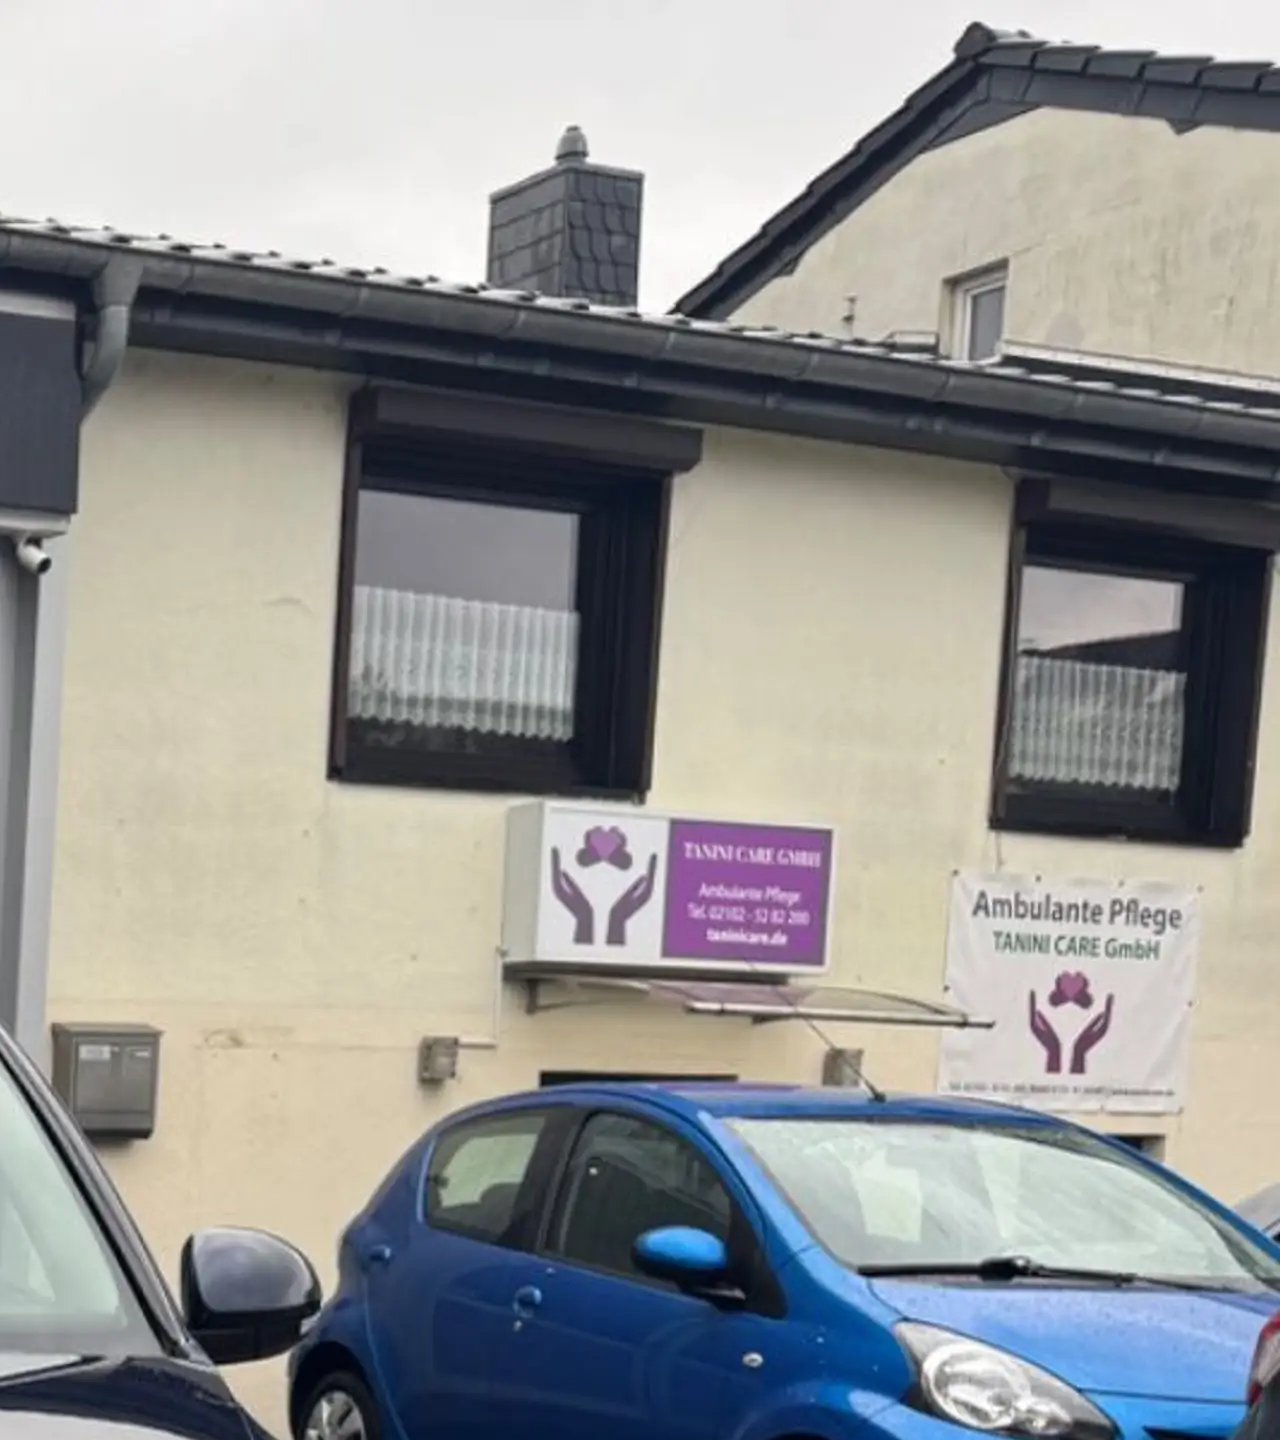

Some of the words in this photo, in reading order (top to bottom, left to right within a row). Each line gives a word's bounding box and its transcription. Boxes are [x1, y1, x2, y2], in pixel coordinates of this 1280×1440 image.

[684, 842, 733, 861] TANINI
[737, 846, 774, 865] CARE
[699, 883, 762, 900] Ambulante
[971, 889, 1103, 926] Ambulante
[1108, 898, 1182, 935] Pflege
[992, 930, 1051, 955] TANINI
[1053, 935, 1101, 958] CARE
[1104, 939, 1161, 961] GmbH
